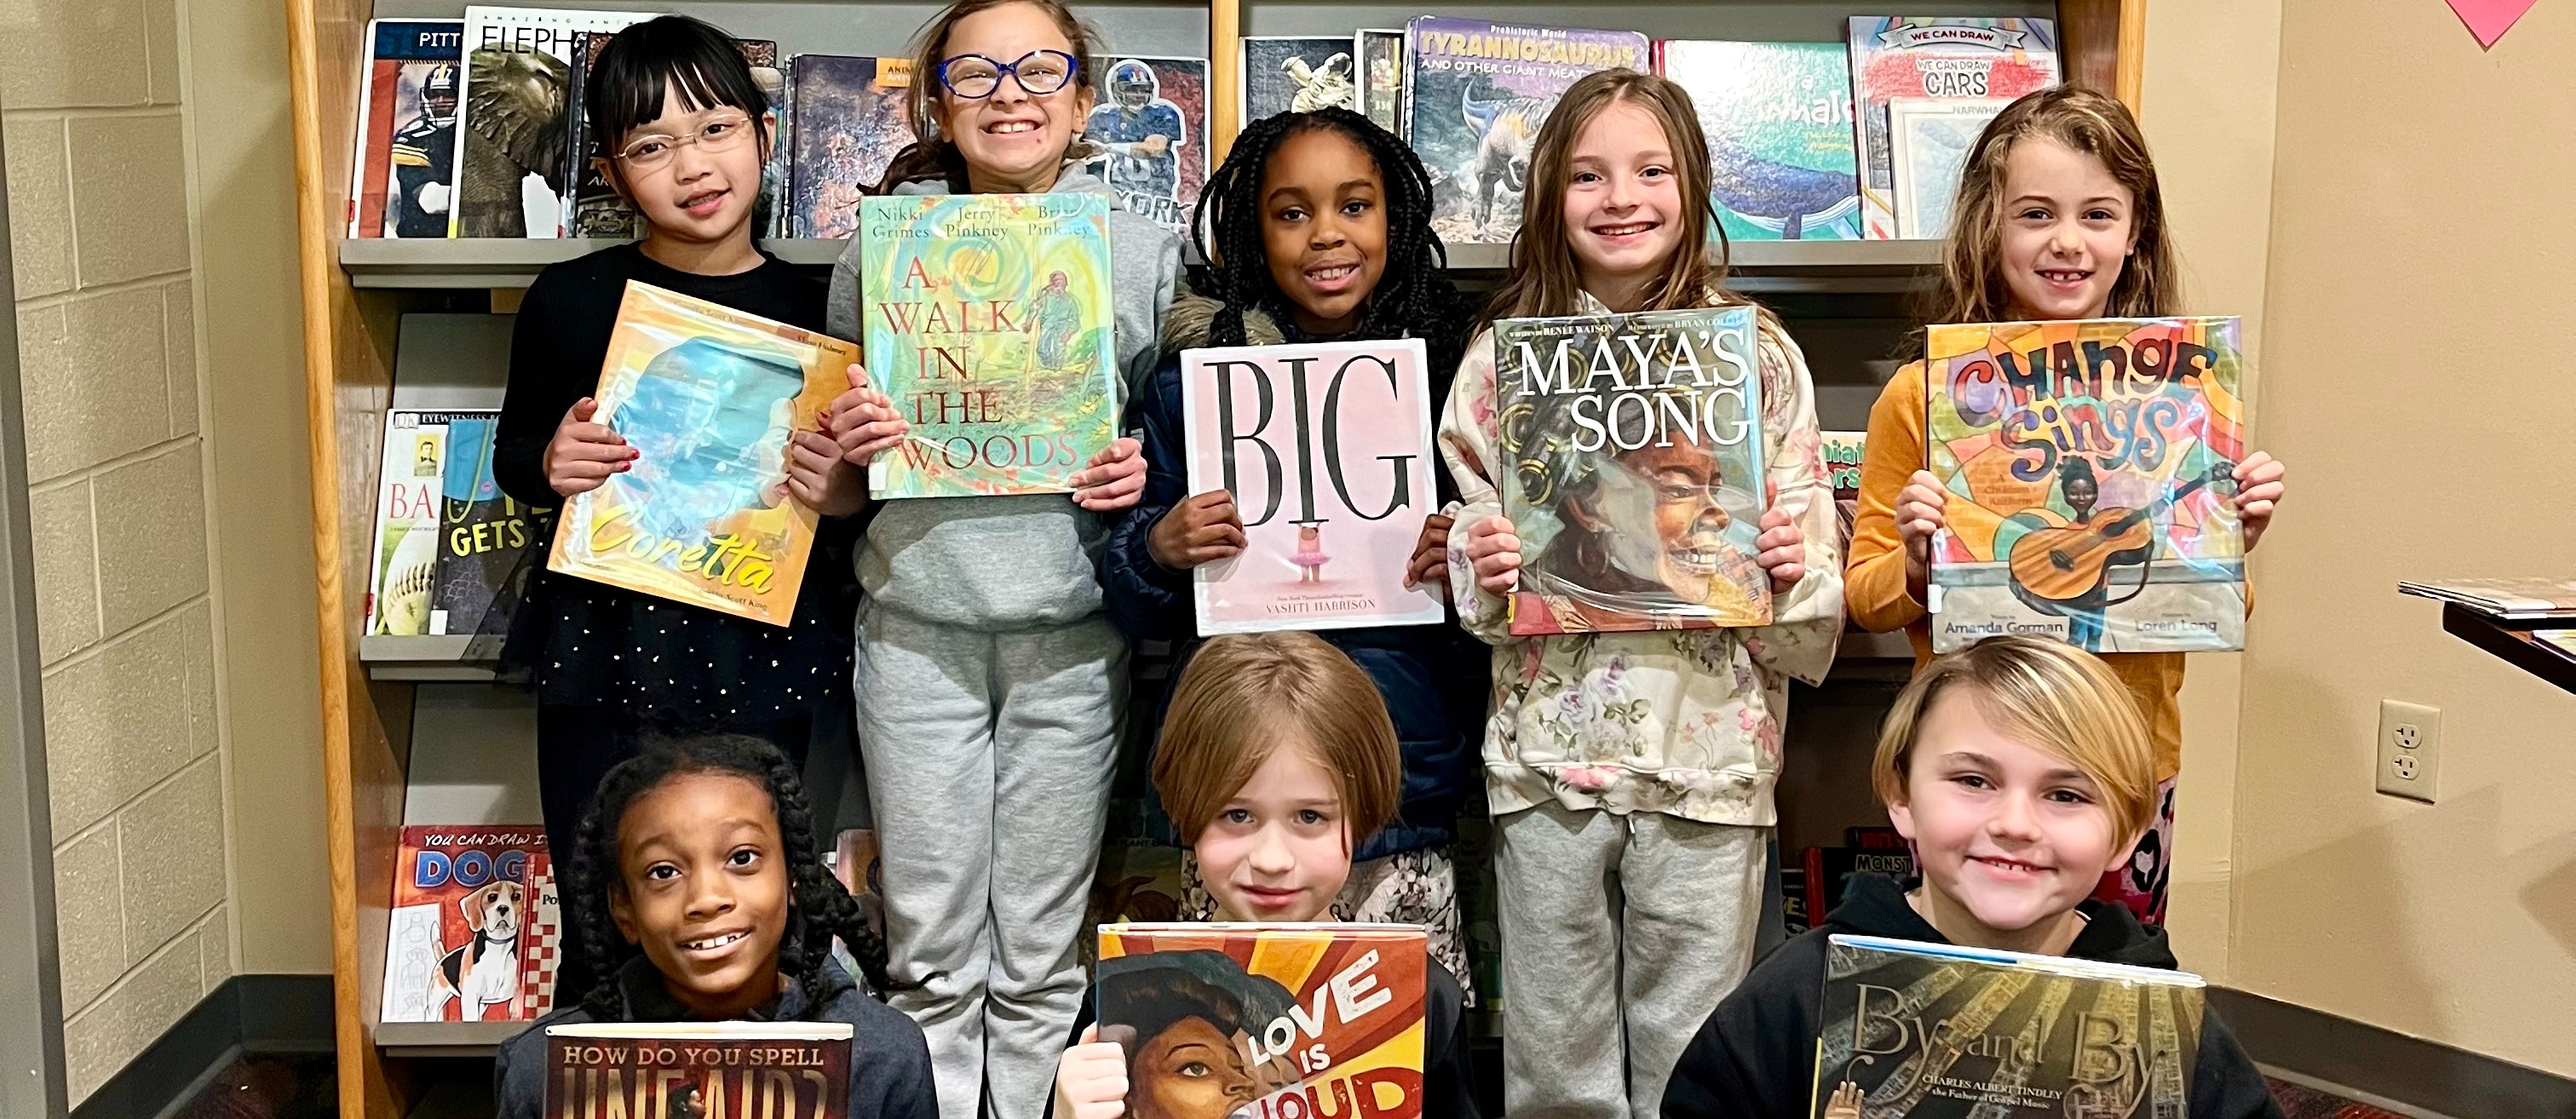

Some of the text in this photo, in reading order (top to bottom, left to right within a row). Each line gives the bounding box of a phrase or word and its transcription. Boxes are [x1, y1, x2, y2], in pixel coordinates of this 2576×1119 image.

[418, 32, 464, 48] PITT
[481, 25, 576, 55] ELEPH
[1541, 28, 1567, 39] World
[1911, 30, 1995, 42] WE CAN DRAW
[1420, 31, 1636, 67] TYRANNOSAURUS
[1420, 58, 1452, 71] AND
[1454, 60, 1500, 75] OTHER
[1502, 64, 1546, 77] GIANT
[1917, 60, 1991, 72] WE CAN DRAW
[1924, 71, 1987, 96] CARS
[1952, 106, 2004, 115] NARWHA
[877, 204, 1078, 224] Nikki Jerry Brian
[1115, 192, 1193, 225] YORK
[872, 222, 1091, 241] Grimes Pinkney Pinkney
[903, 255, 932, 290] A
[879, 300, 1021, 336] WALK
[1575, 324, 1614, 334] WATSON
[1674, 318, 1706, 329] BRYAN
[916, 345, 971, 381] IN
[1514, 328, 1749, 397] MAYA'S
[397, 413, 418, 428] DK
[905, 390, 1003, 426] THE
[1570, 387, 1755, 453] SONG
[899, 433, 1078, 471] WOODS
[1202, 354, 1417, 527] BIG
[389, 483, 435, 519] BA
[450, 519, 526, 558] GETS
[589, 502, 774, 594] Coretta
[1266, 599, 1376, 614] VASHTI HARRISON
[1945, 621, 2064, 634] Amanda Gorman
[2134, 619, 2218, 634] Loren Long
[424, 834, 455, 846] YOU
[457, 833, 488, 846] CAN
[487, 833, 531, 846] DRAW
[1854, 853, 1912, 873] MONST
[1247, 948, 1393, 1068] LOVE
[563, 1046, 825, 1065] HOW DO YOU SPELL
[1298, 1042, 1331, 1074] IS
[1845, 983, 2167, 1119] By and By
[1922, 1074, 2063, 1100] CHARLES ALBERT TINDLEY
